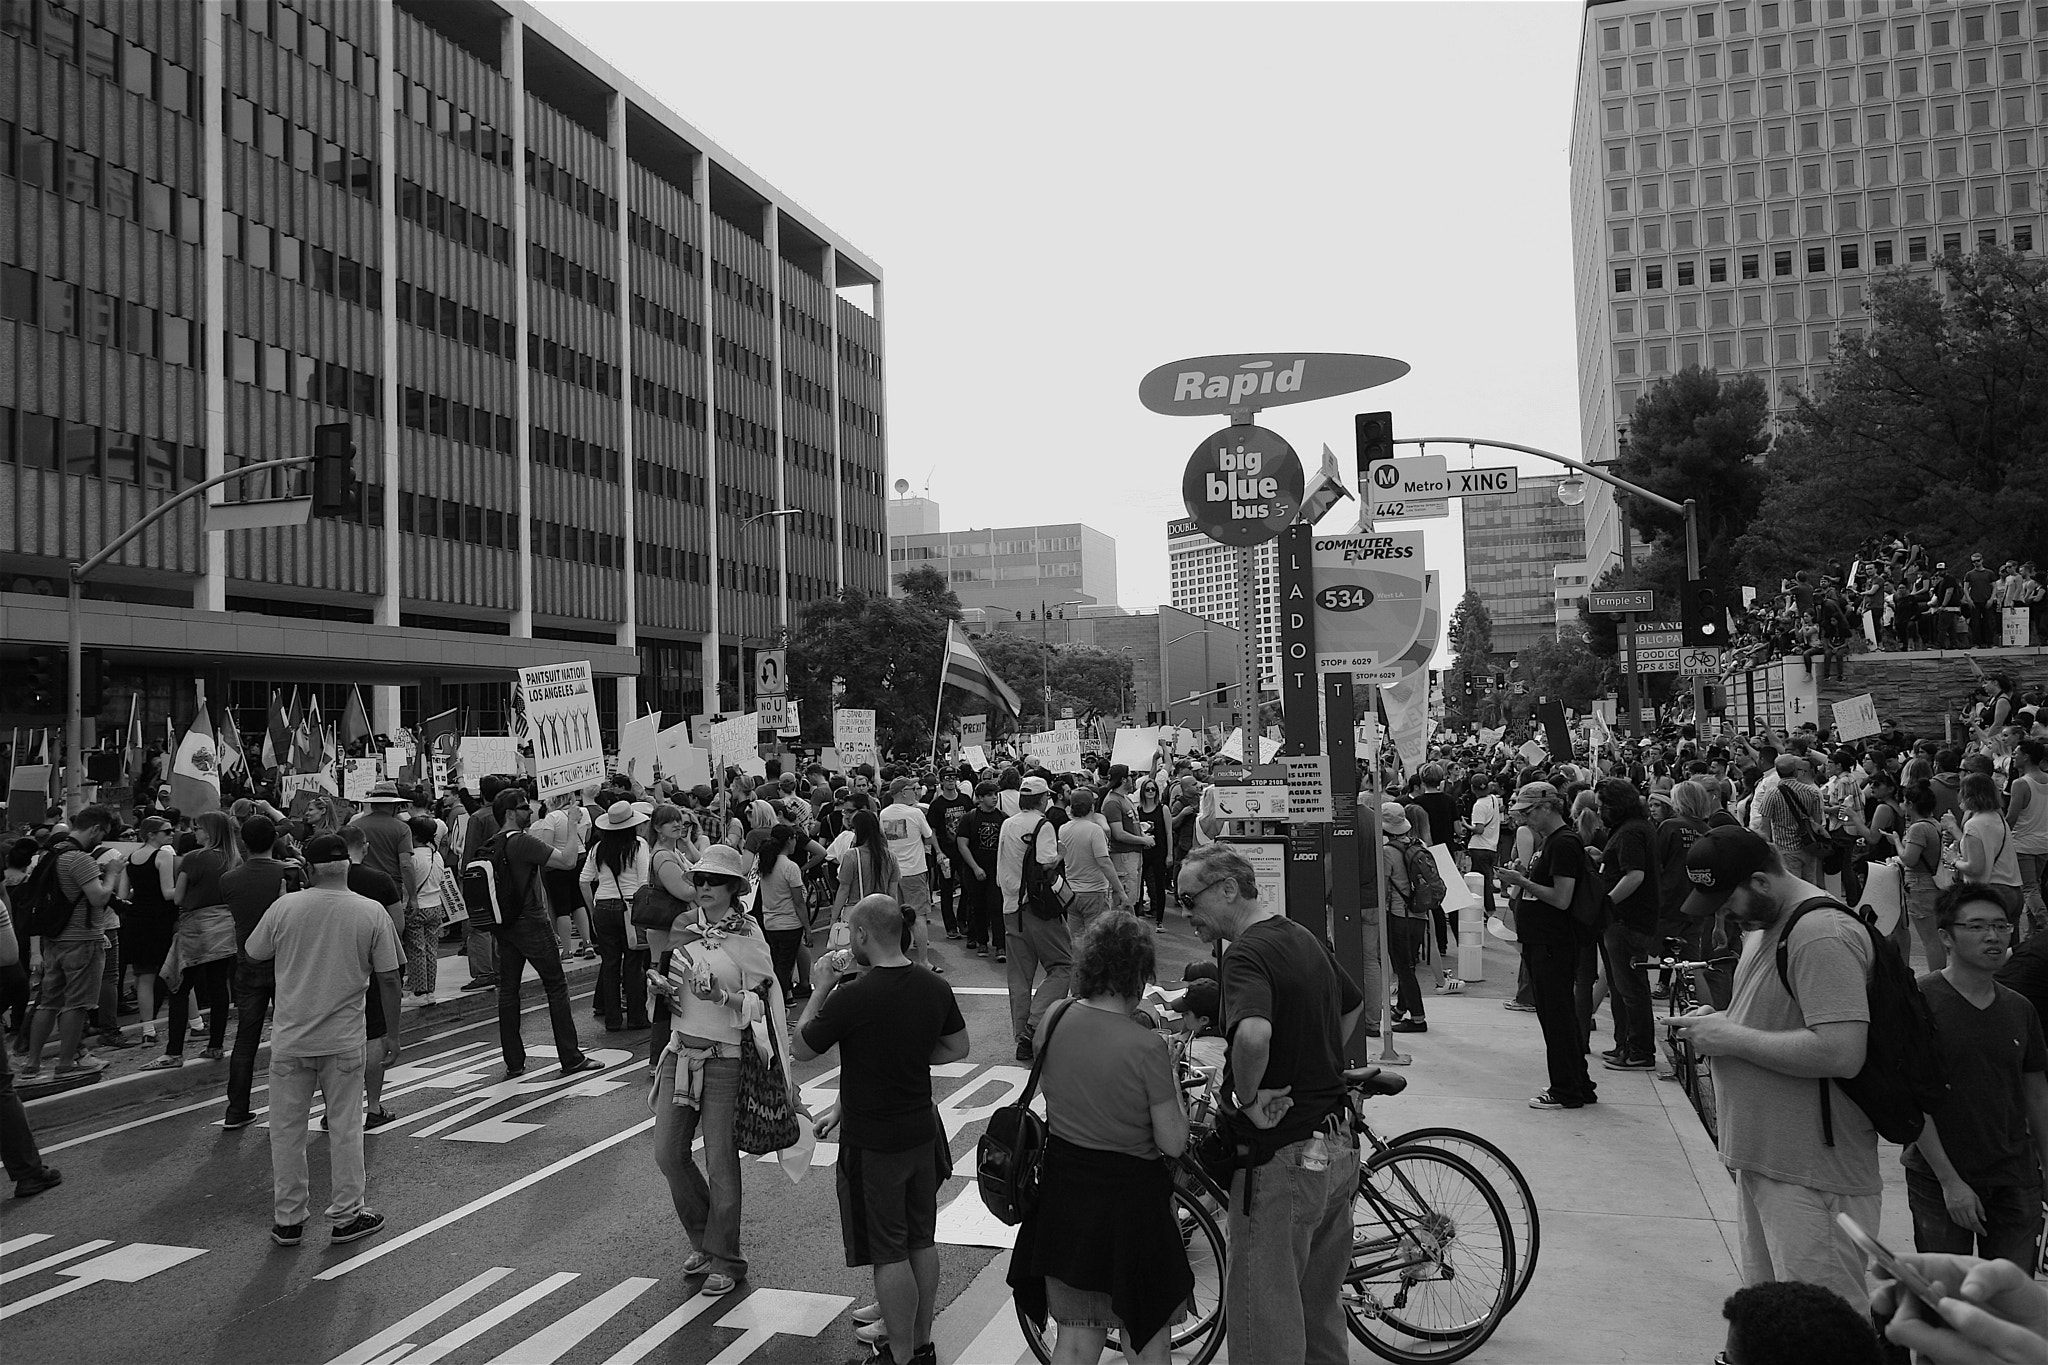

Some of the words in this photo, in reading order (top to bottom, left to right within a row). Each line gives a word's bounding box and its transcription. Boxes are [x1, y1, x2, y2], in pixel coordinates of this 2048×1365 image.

[1173, 359, 1306, 405] Rapid
[1219, 445, 1262, 476] big
[1206, 471, 1279, 502] blue
[1404, 481, 1443, 493] Metro
[1461, 473, 1508, 492] XING
[1231, 501, 1270, 520] bus
[1376, 502, 1405, 517] 442
[1315, 537, 1393, 551] COMMUTER
[1344, 546, 1413, 561] EXPRESS
[1325, 589, 1365, 609] 534
[1595, 597, 1630, 606] Temple
[1635, 596, 1647, 604] St
[1636, 623, 1654, 632] OS
[1636, 650, 1664, 660] FOOD
[1320, 659, 1347, 667] STOP#
[1352, 658, 1372, 666] 6029
[1622, 662, 1656, 673] SOPS
[525, 669, 561, 686] PANTSUIT
[561, 666, 586, 680] NATION
[528, 689, 543, 703] LOS
[544, 684, 574, 700] ANGELES
[761, 702, 772, 711] NO
[774, 699, 782, 712] U
[761, 714, 783, 724] TURN
[846, 710, 862, 718] STAND
[840, 726, 854, 734] PEOPLE
[962, 722, 986, 735] PREXIT
[1032, 731, 1079, 745] IMMIGRANTS
[1032, 747, 1050, 757] MAKE
[559, 766, 584, 782] TRUMPS
[584, 762, 600, 776] HATE
[1046, 758, 1066, 772] GREAT
[1217, 770, 1242, 778] nextbus
[304, 776, 320, 790] MY
[1293, 853, 1318, 861] LADOT
[747, 1095, 788, 1121] PANAMA
